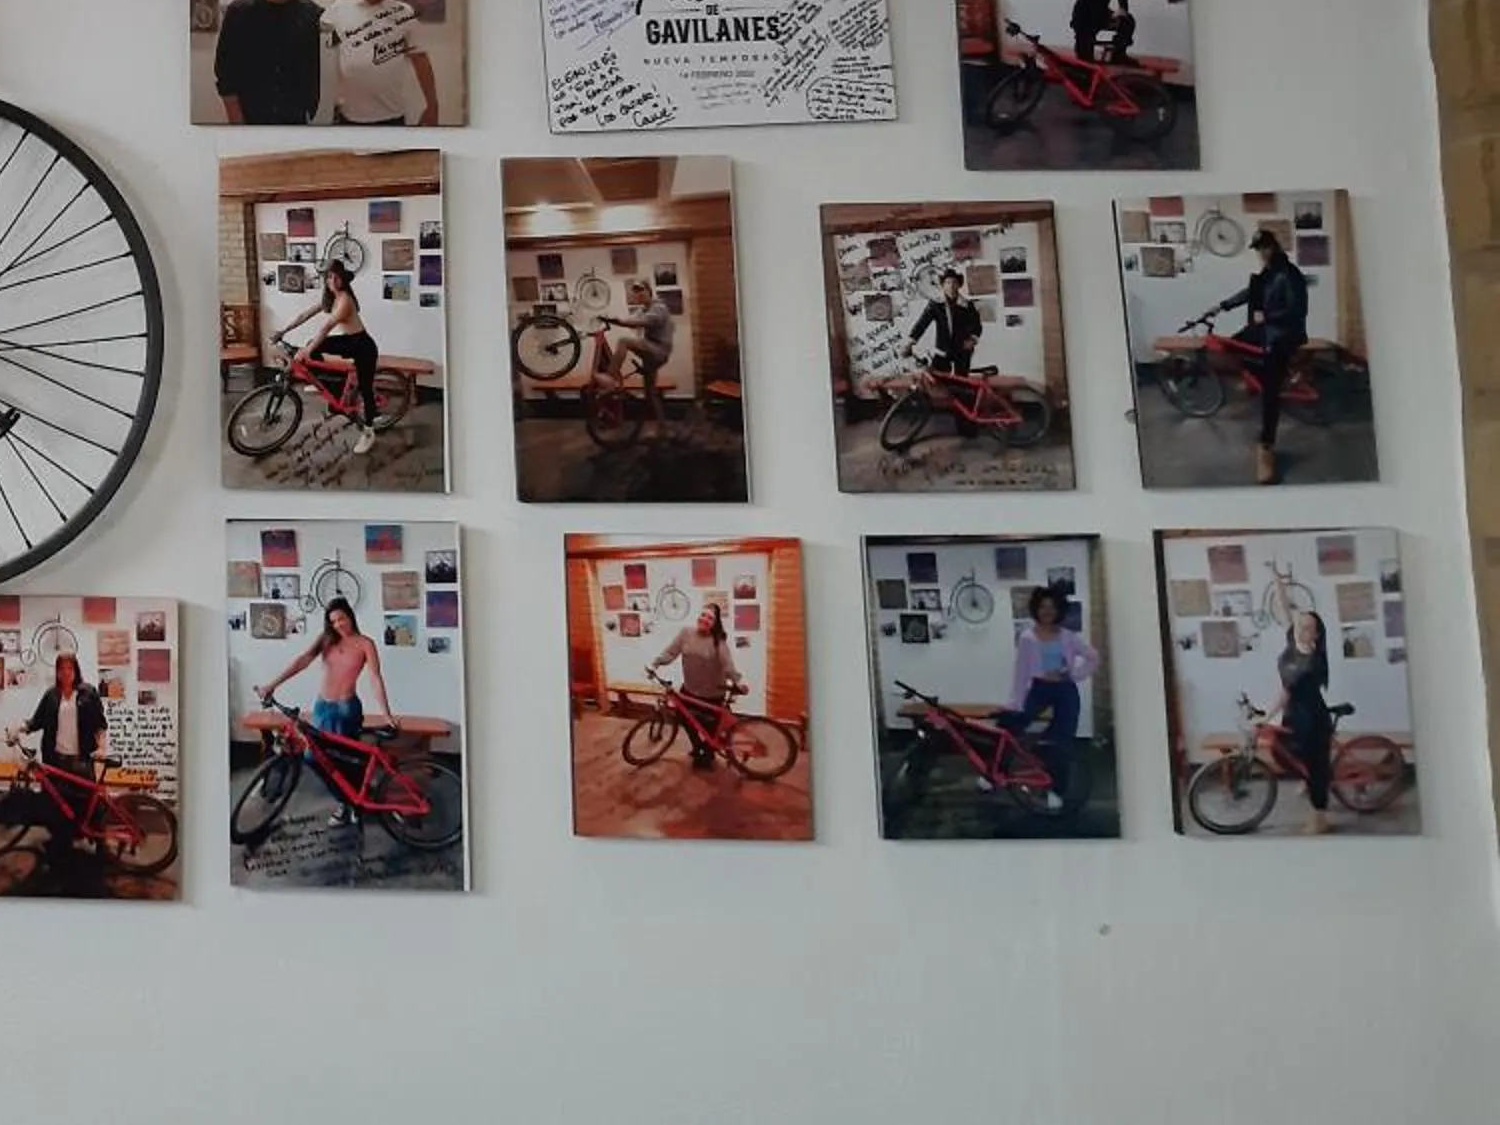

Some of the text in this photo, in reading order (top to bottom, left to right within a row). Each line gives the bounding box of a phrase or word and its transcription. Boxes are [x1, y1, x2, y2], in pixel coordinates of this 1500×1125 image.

[705, 3, 720, 16] DE
[645, 15, 780, 45] GAVILANES
[643, 55, 691, 66] NUEVA
